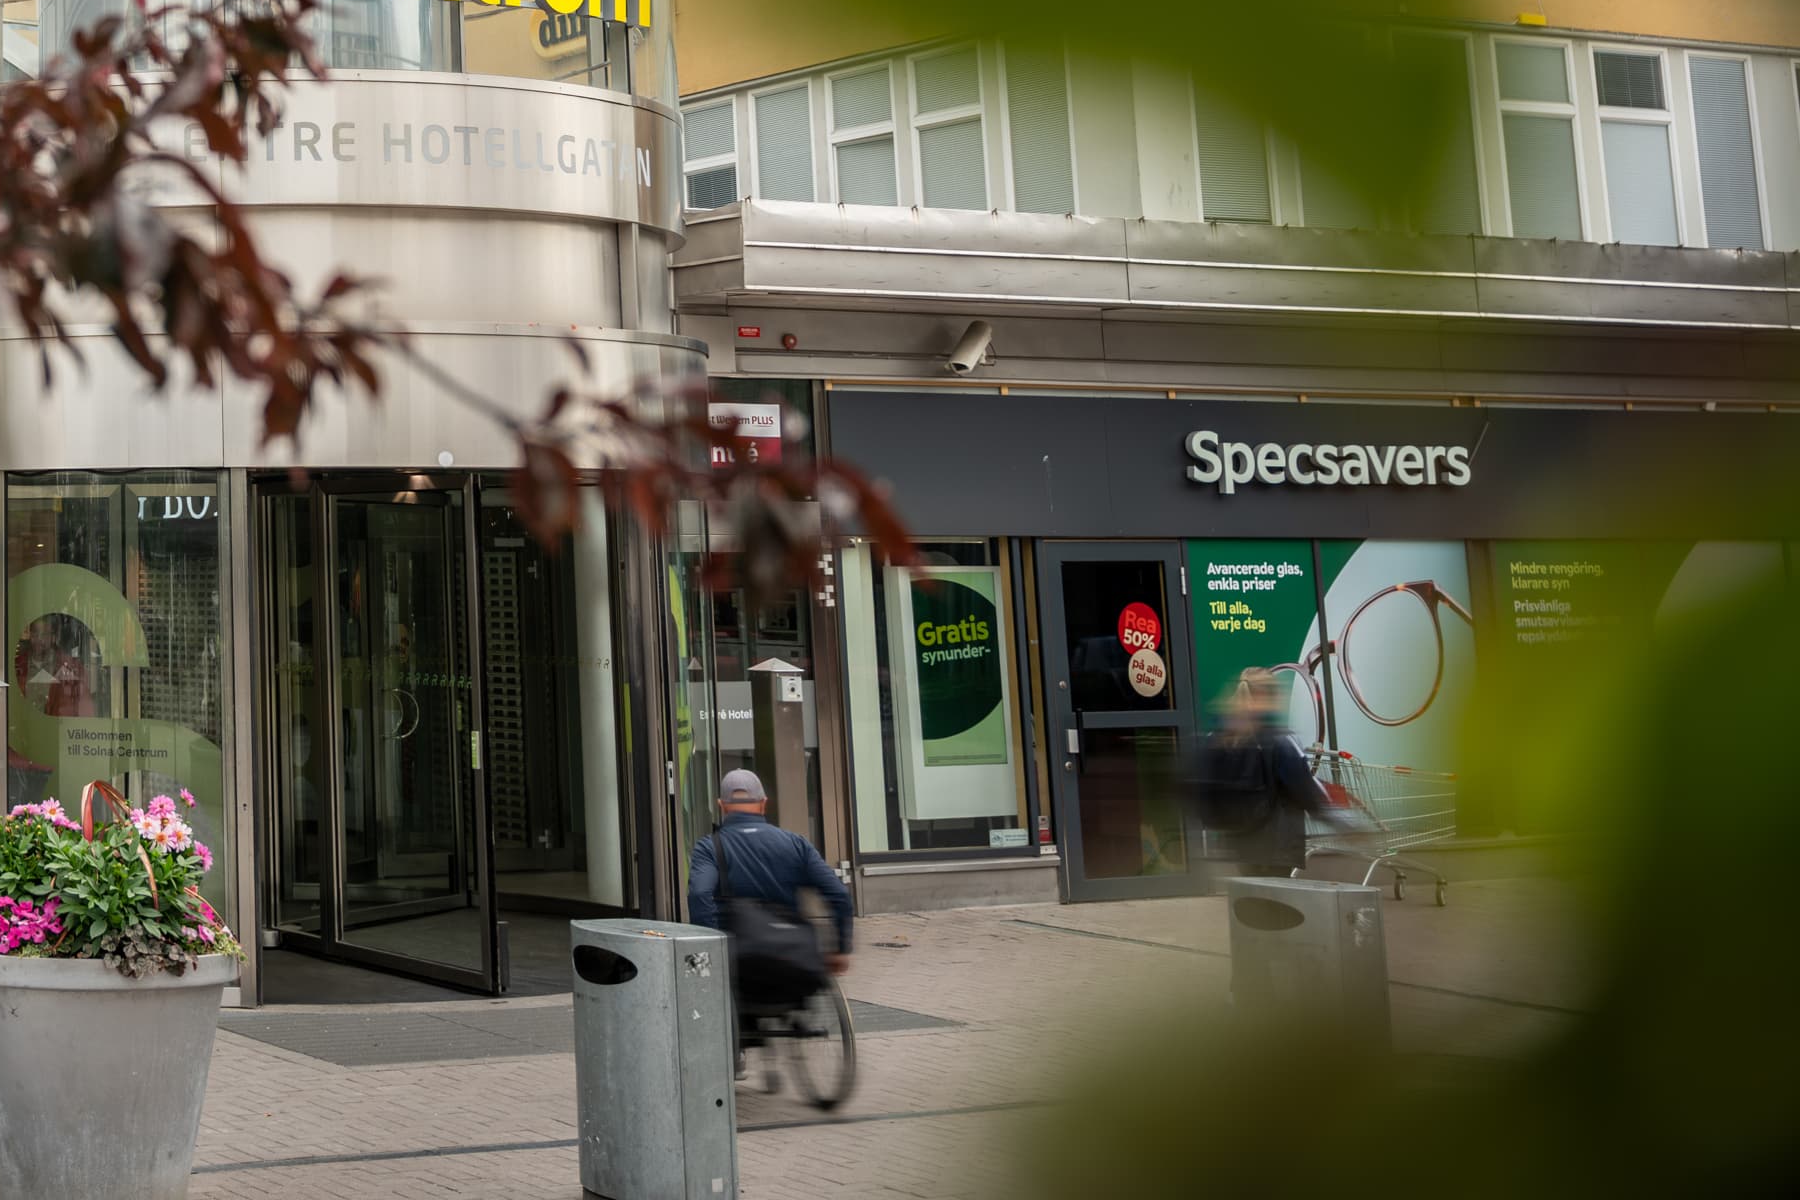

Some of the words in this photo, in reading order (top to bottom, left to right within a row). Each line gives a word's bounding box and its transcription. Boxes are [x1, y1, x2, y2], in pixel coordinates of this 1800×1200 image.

[184, 120, 356, 163] ETRE
[383, 121, 652, 188] HOTELLGATAN
[751, 415, 774, 425] PLUS
[1186, 430, 1471, 494] Specsavers
[1207, 561, 1275, 575] Avancerade
[1277, 561, 1303, 578] glas,
[1510, 561, 1546, 575] Mindre
[1207, 576, 1240, 591] enkla
[1242, 576, 1277, 593] priser
[1511, 577, 1549, 589] klarare
[1552, 579, 1570, 591] syn
[1209, 601, 1227, 615] Till
[1229, 601, 1252, 616] alla,
[917, 613, 989, 647] Gratis
[1124, 609, 1157, 634] Rea
[1211, 616, 1241, 633] varje
[1243, 616, 1266, 633] dag
[1123, 628, 1155, 650] 50%
[922, 644, 991, 666] synunder-
[1132, 659, 1145, 670] på
[1146, 664, 1163, 678] alla
[1136, 672, 1156, 687] glas
[67, 728, 133, 741] Välkommen
[67, 744, 80, 756] till
[82, 745, 114, 757] Solna
[117, 746, 168, 758] Centrum
